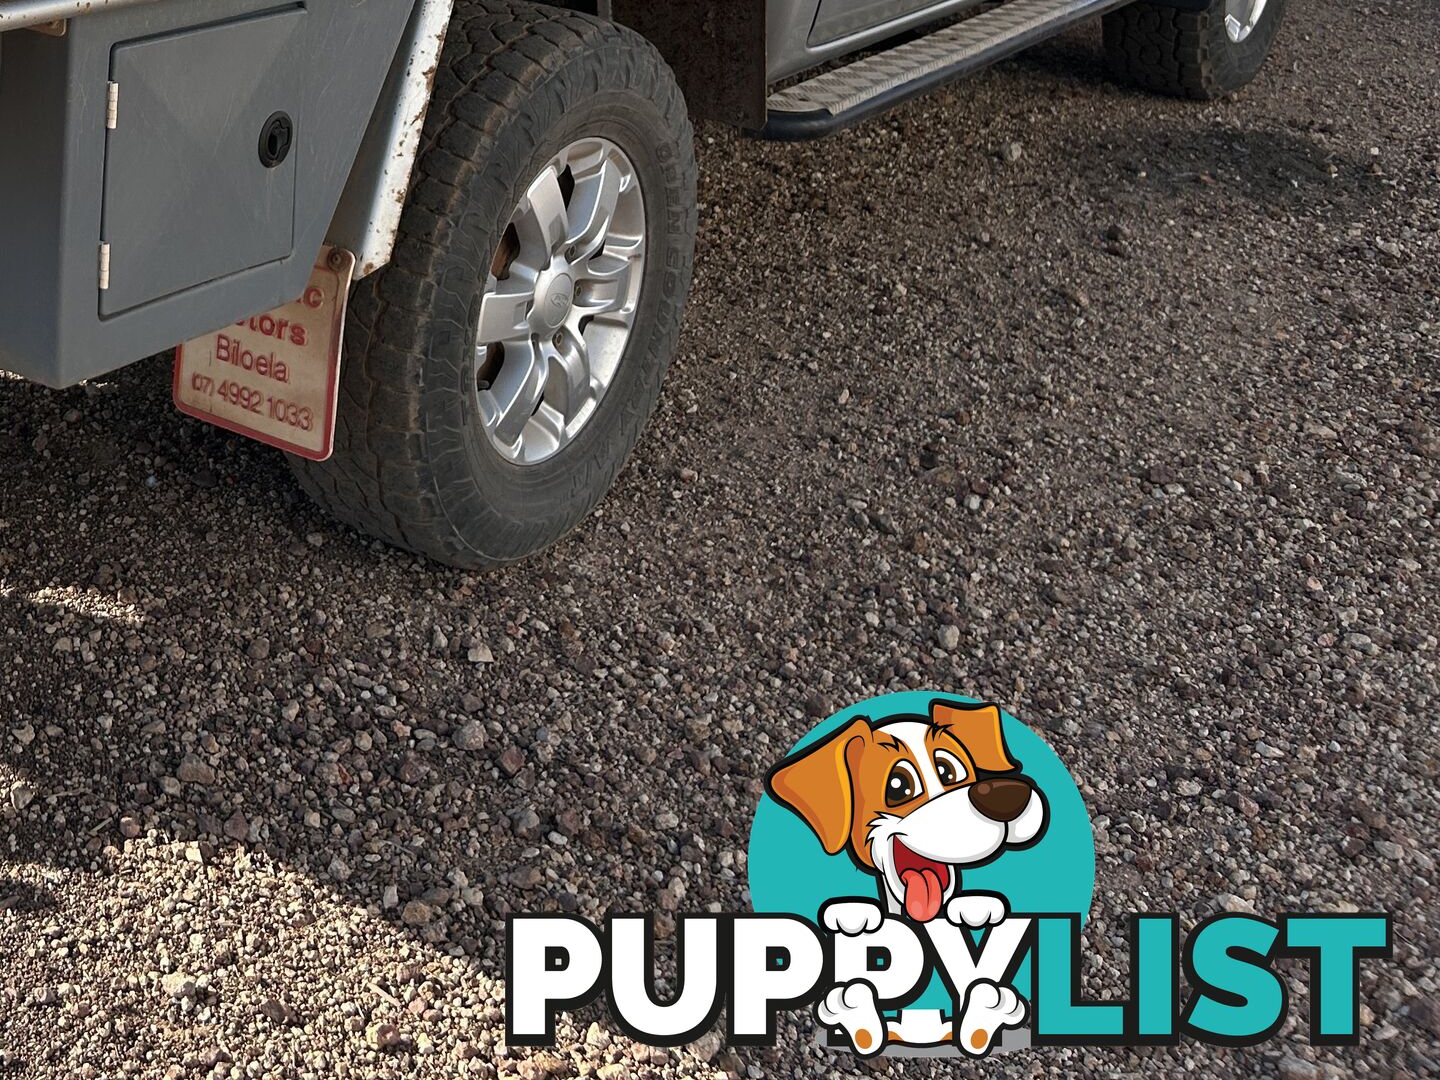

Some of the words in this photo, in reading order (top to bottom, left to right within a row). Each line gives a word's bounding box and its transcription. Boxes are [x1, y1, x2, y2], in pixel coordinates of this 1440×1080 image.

[654, 141, 682, 234] OPEN
[216, 333, 288, 383] Biloela
[217, 381, 263, 414] 4992
[267, 395, 313, 431] 1033
